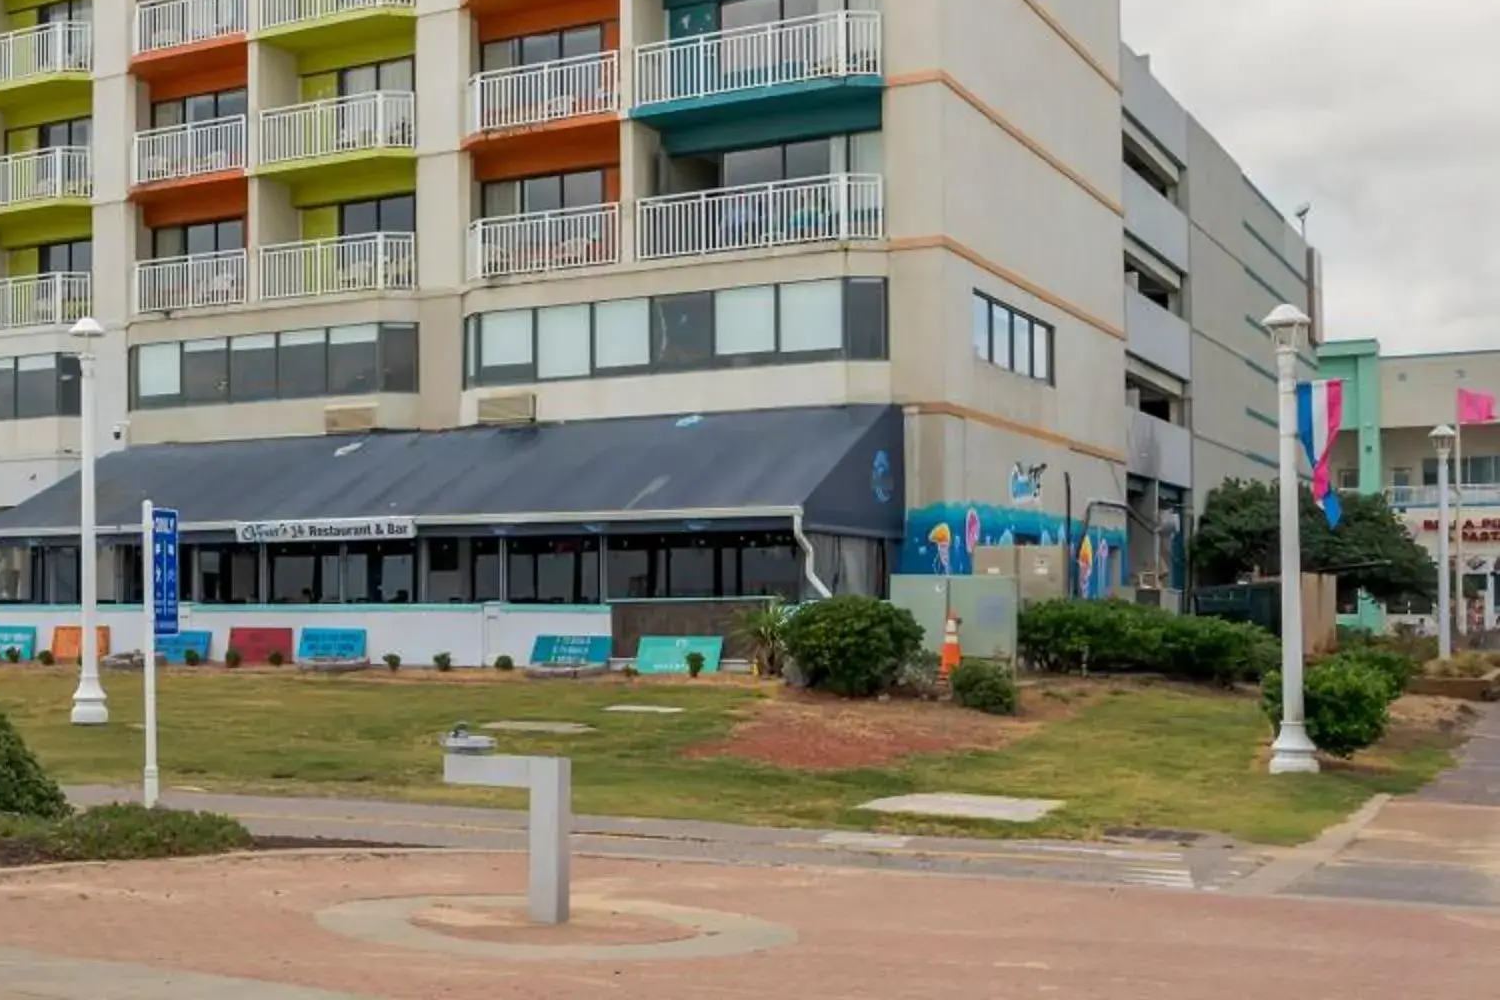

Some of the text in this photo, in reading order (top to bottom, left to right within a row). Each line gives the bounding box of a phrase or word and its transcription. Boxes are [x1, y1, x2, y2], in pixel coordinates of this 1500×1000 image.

[309, 524, 371, 537] Restaurant
[375, 523, 384, 535] &
[387, 523, 408, 535] Bar
